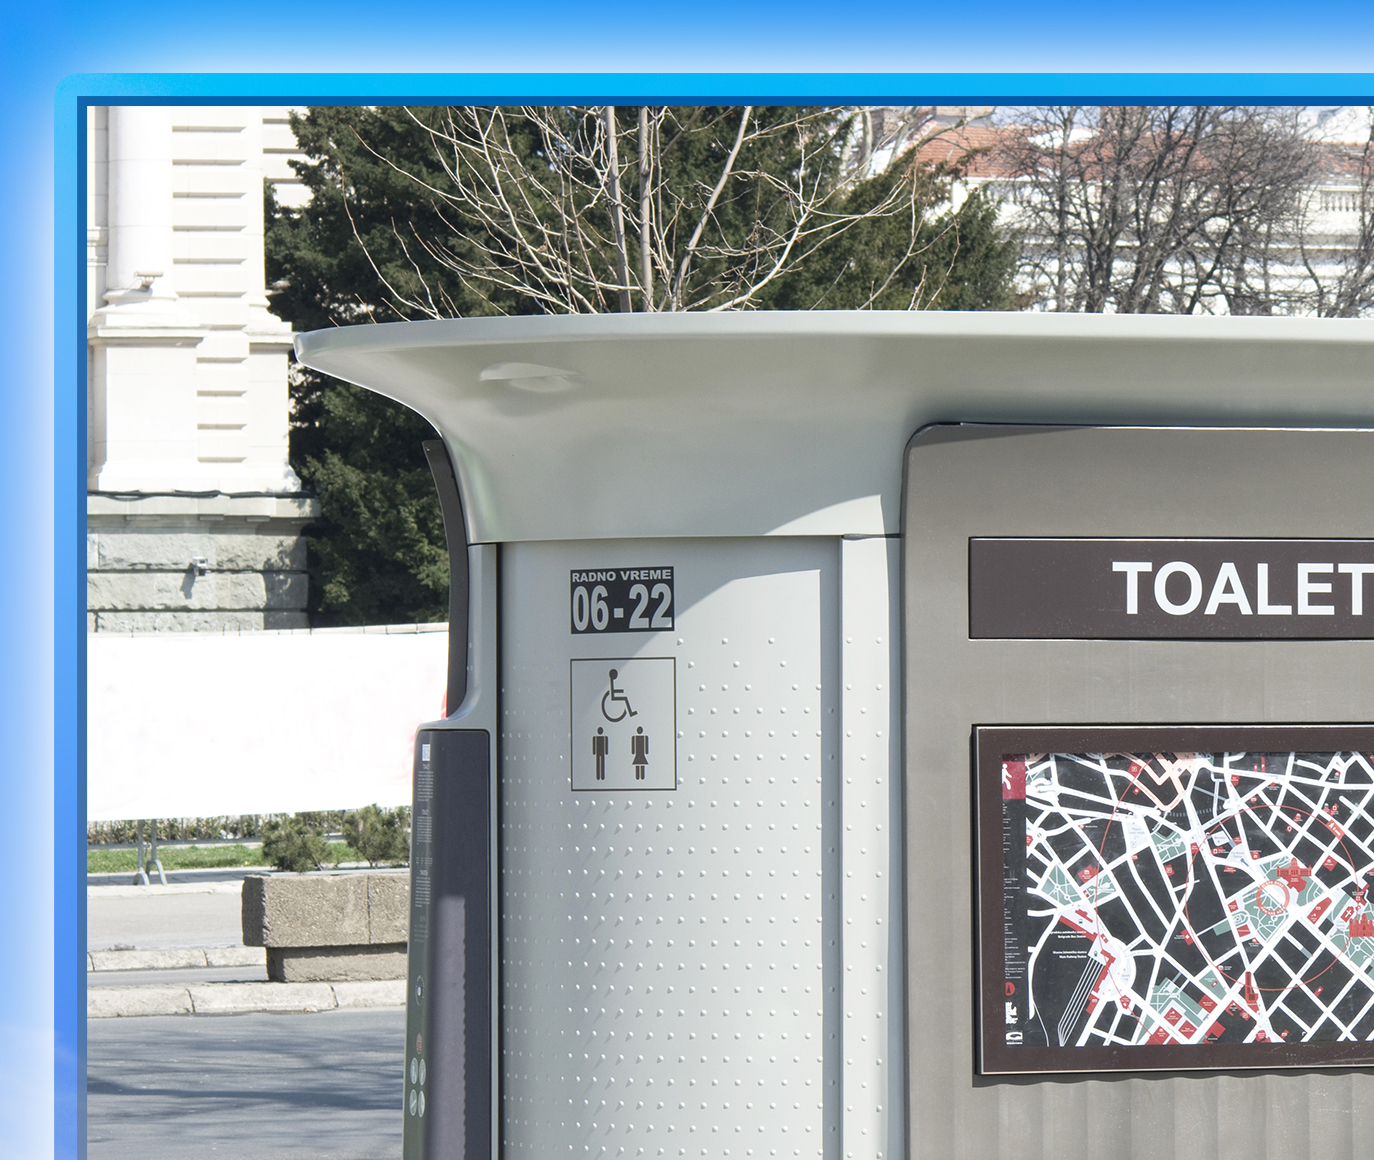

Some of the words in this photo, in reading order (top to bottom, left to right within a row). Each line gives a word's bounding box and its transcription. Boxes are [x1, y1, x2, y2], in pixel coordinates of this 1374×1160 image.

[572, 572, 616, 583] RADNO
[620, 570, 672, 581] VREME
[572, 583, 673, 631] 06-22
